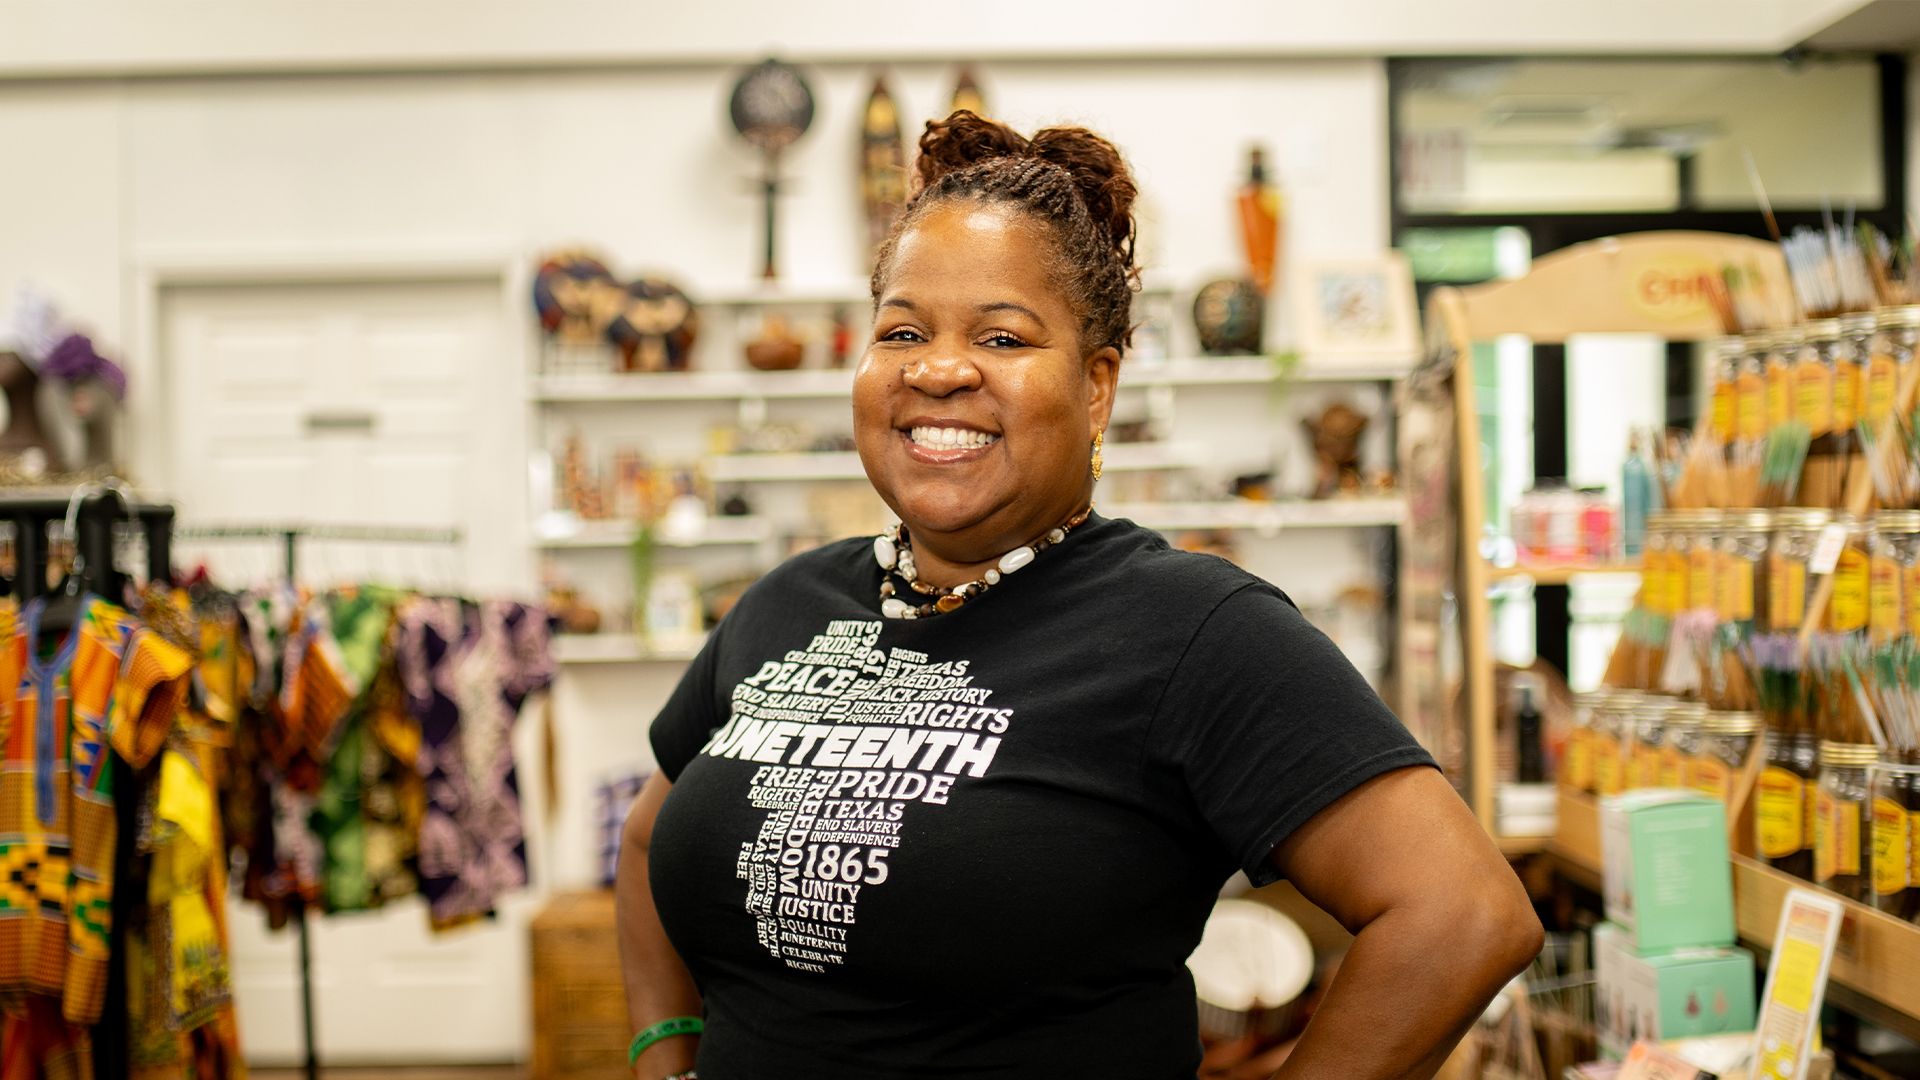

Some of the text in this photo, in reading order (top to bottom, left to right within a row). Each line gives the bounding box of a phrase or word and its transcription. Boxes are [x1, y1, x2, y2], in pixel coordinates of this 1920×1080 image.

[826, 620, 867, 637] UNITY
[806, 635, 862, 654] PRIDE
[848, 620, 883, 669] 1865
[890, 647, 929, 664] RIGHTS
[784, 650, 852, 668] CELEBRATE
[862, 649, 886, 677] 19
[899, 660, 970, 680] TEXAS
[744, 661, 858, 697] PEACE
[732, 683, 836, 713] END SLAVERY
[858, 687, 993, 706] BLACK HISTORY
[753, 707, 823, 724] INDEPENDENCE
[844, 701, 908, 716] JUSTICE
[845, 714, 900, 725] EQUALITY
[896, 702, 1014, 734] RIGHTS
[750, 766, 816, 789] FREE
[829, 770, 956, 805] PRIDE
[747, 786, 806, 802] RIGHTS
[751, 799, 800, 811] CELEBRATE
[823, 800, 906, 821] TEXAS
[765, 810, 796, 864] UNITY
[779, 769, 840, 896] FREEDOM
[814, 819, 903, 835] END SLAVERY
[809, 831, 901, 848] INDEPENDENCE
[736, 841, 754, 880] FREE
[803, 844, 889, 885] 1865
[750, 810, 781, 949] TEXAS END SLAVERY
[801, 879, 861, 904] UNITY
[761, 863, 781, 958] BLACK HISTORY
[776, 895, 856, 925] JUSTICE
[778, 917, 847, 941] EQUALITY
[780, 931, 848, 953] JUNETEENTH
[782, 945, 845, 965] CELEBRATE
[785, 958, 826, 974] RIGHTS
